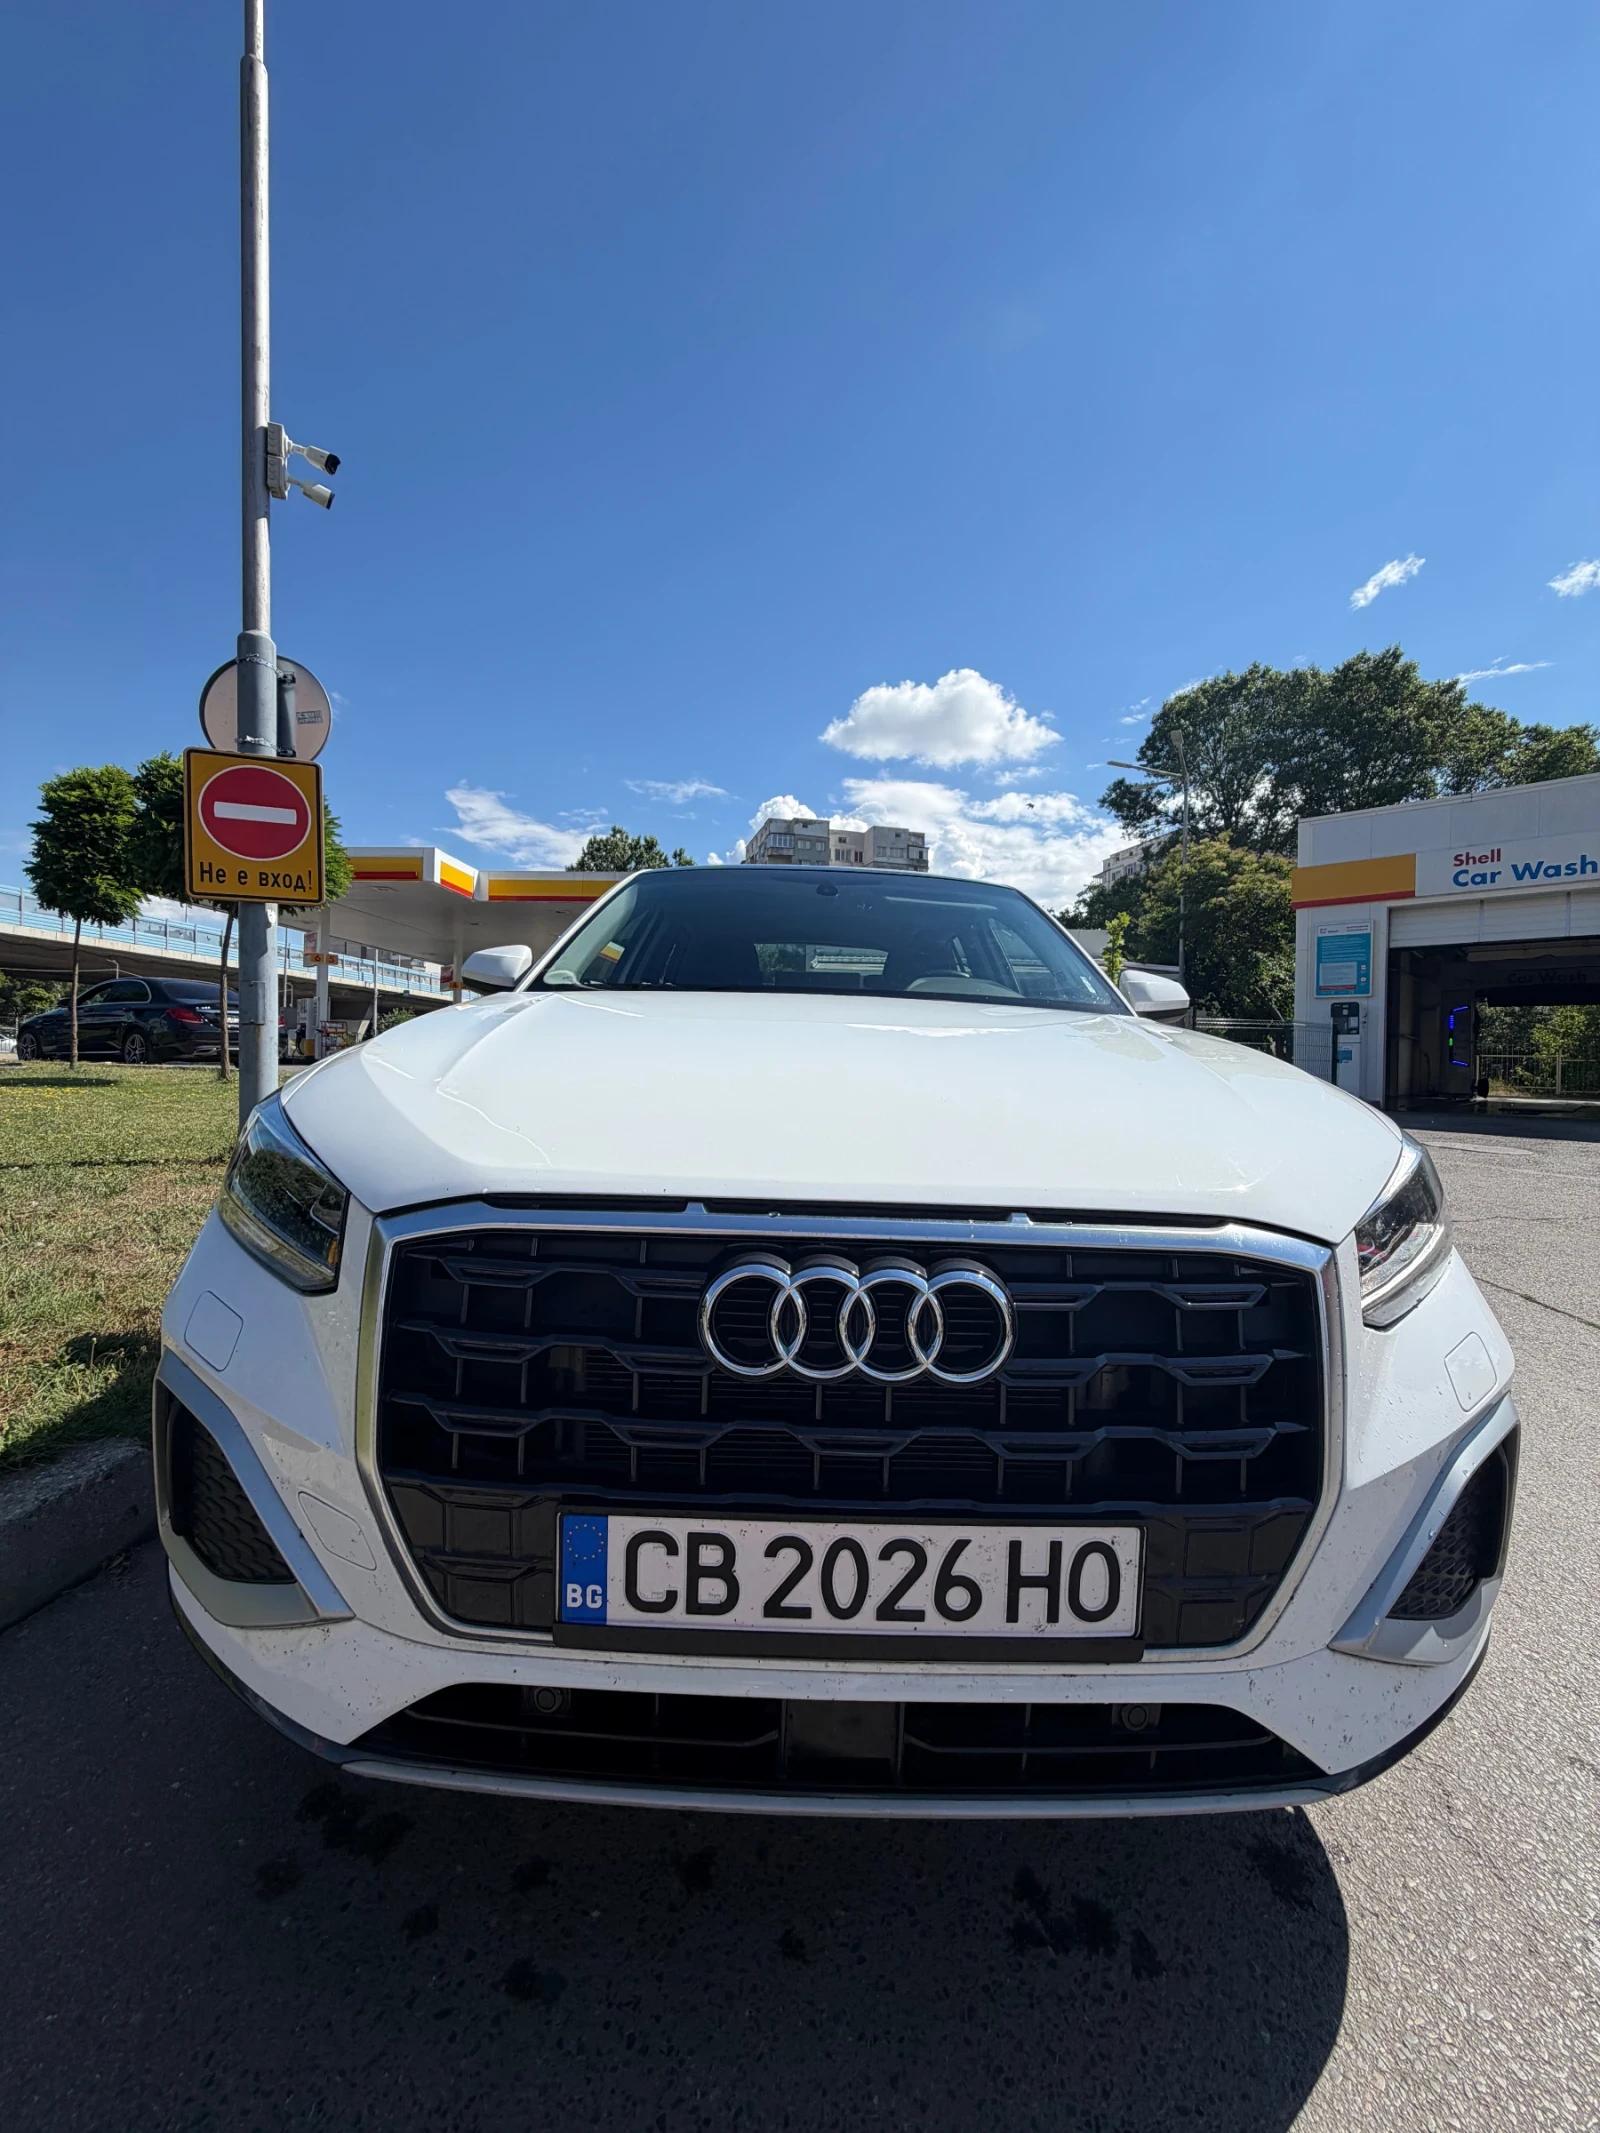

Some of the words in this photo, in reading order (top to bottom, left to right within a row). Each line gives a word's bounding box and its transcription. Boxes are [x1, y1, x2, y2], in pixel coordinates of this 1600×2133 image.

[1453, 848, 1501, 867] Shell
[1453, 869, 1502, 887] Car
[1511, 854, 1598, 881] Wash
[200, 861, 226, 884] Не
[238, 870, 248, 885] е
[259, 870, 312, 892] вход!
[1538, 969, 1587, 984] Wash
[624, 1530, 740, 1616] CB
[762, 1535, 983, 1623] 2026
[1005, 1539, 1121, 1624] HO
[565, 1583, 603, 1609] BG
